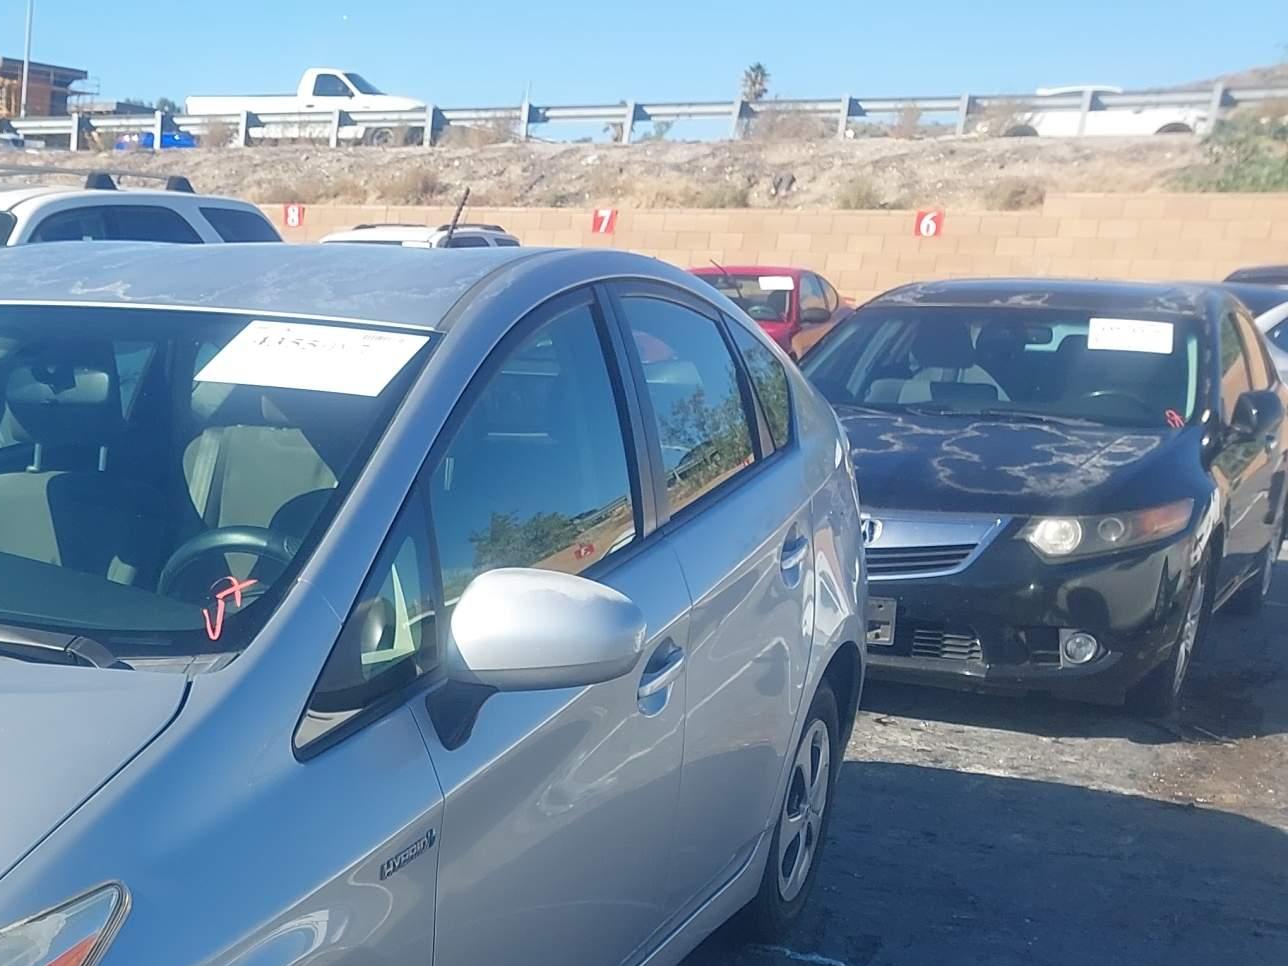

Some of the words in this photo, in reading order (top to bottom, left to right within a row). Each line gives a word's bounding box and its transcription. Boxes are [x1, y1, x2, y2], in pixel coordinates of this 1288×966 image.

[286, 204, 300, 227] 8
[597, 208, 613, 233] 7
[919, 211, 938, 237] 6
